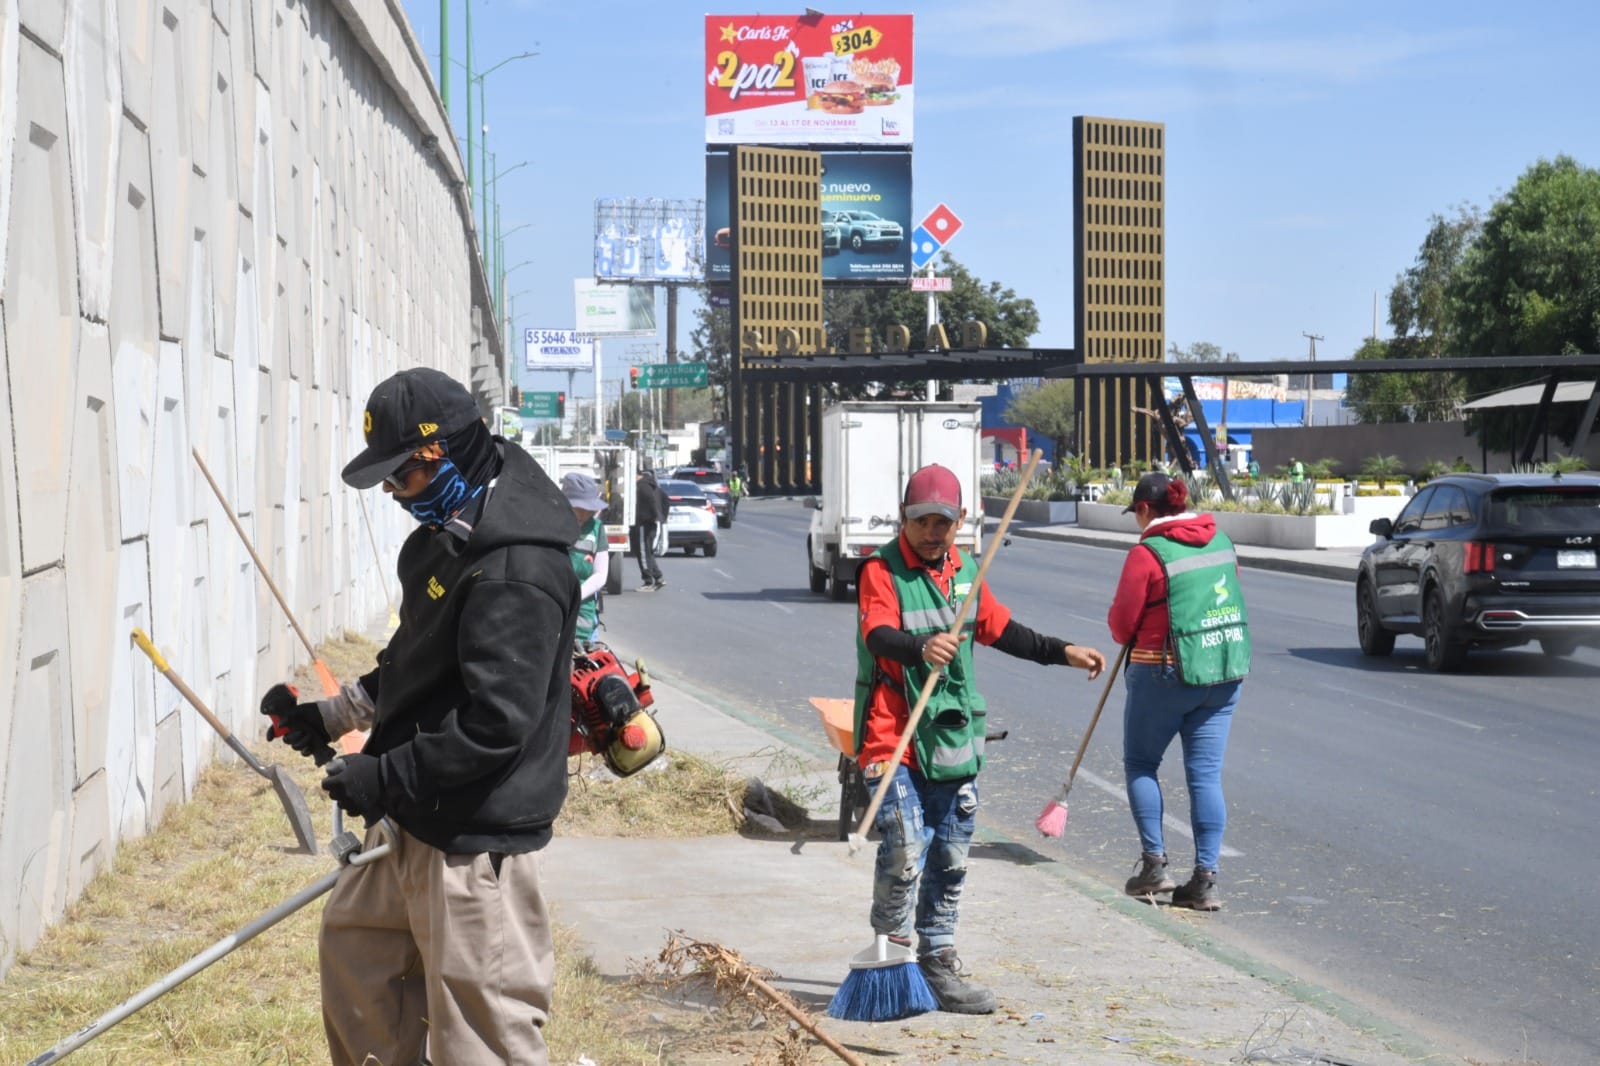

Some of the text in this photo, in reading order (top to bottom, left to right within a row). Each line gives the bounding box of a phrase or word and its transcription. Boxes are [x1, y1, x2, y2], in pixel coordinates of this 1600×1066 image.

[737, 25, 772, 41] Carl's
[836, 29, 874, 52] $304
[801, 119, 812, 127] DE
[813, 119, 857, 127] NOVIEMBRE
[829, 183, 871, 193] nuevo
[526, 331, 540, 344] 55
[541, 331, 566, 344] 5646
[742, 320, 987, 355] SOLEDAD
